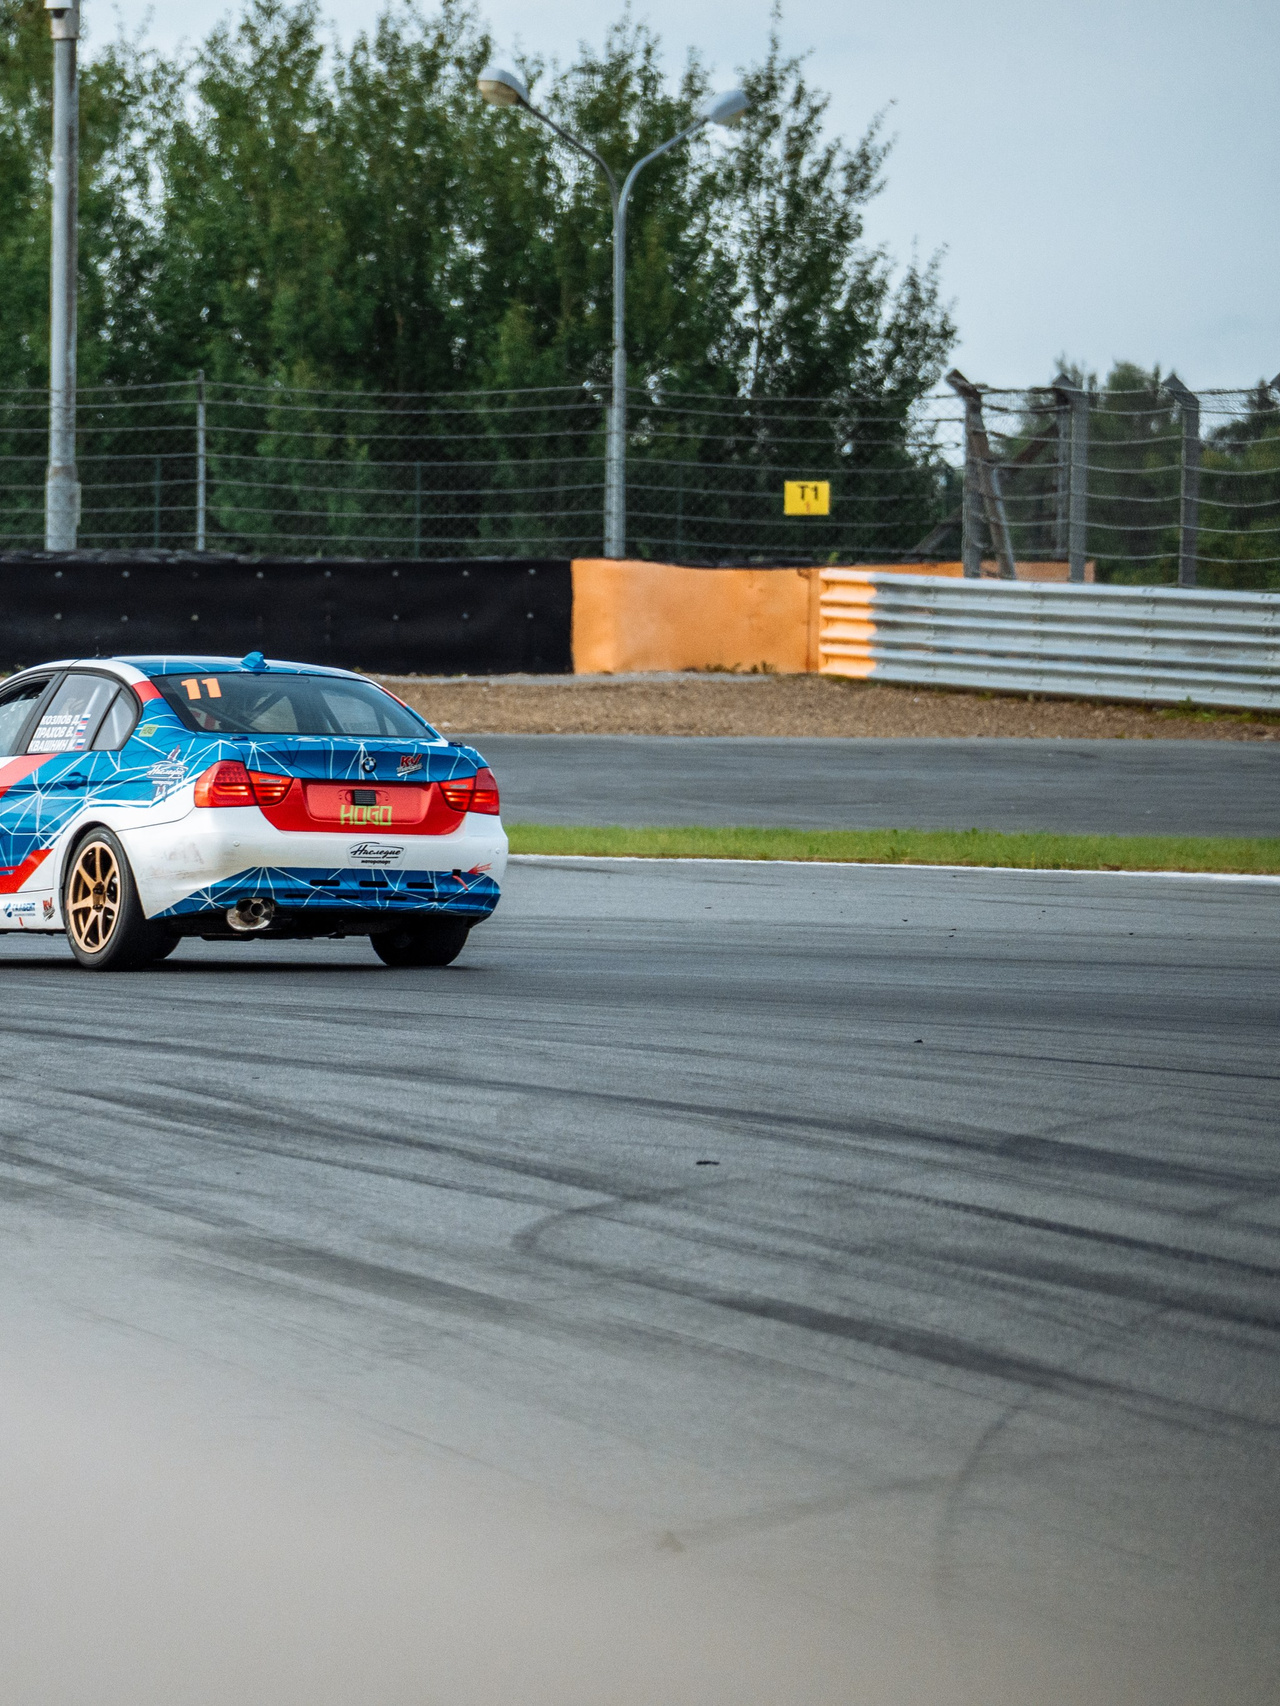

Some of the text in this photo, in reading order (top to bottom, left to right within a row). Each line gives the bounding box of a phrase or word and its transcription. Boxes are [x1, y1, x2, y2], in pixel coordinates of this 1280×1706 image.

[797, 484, 819, 500] T1
[180, 677, 222, 700] 11
[40, 714, 73, 726] КОЗЛОВ
[33, 726, 68, 739] ПРАХОВ
[340, 804, 393, 826] HOGO
